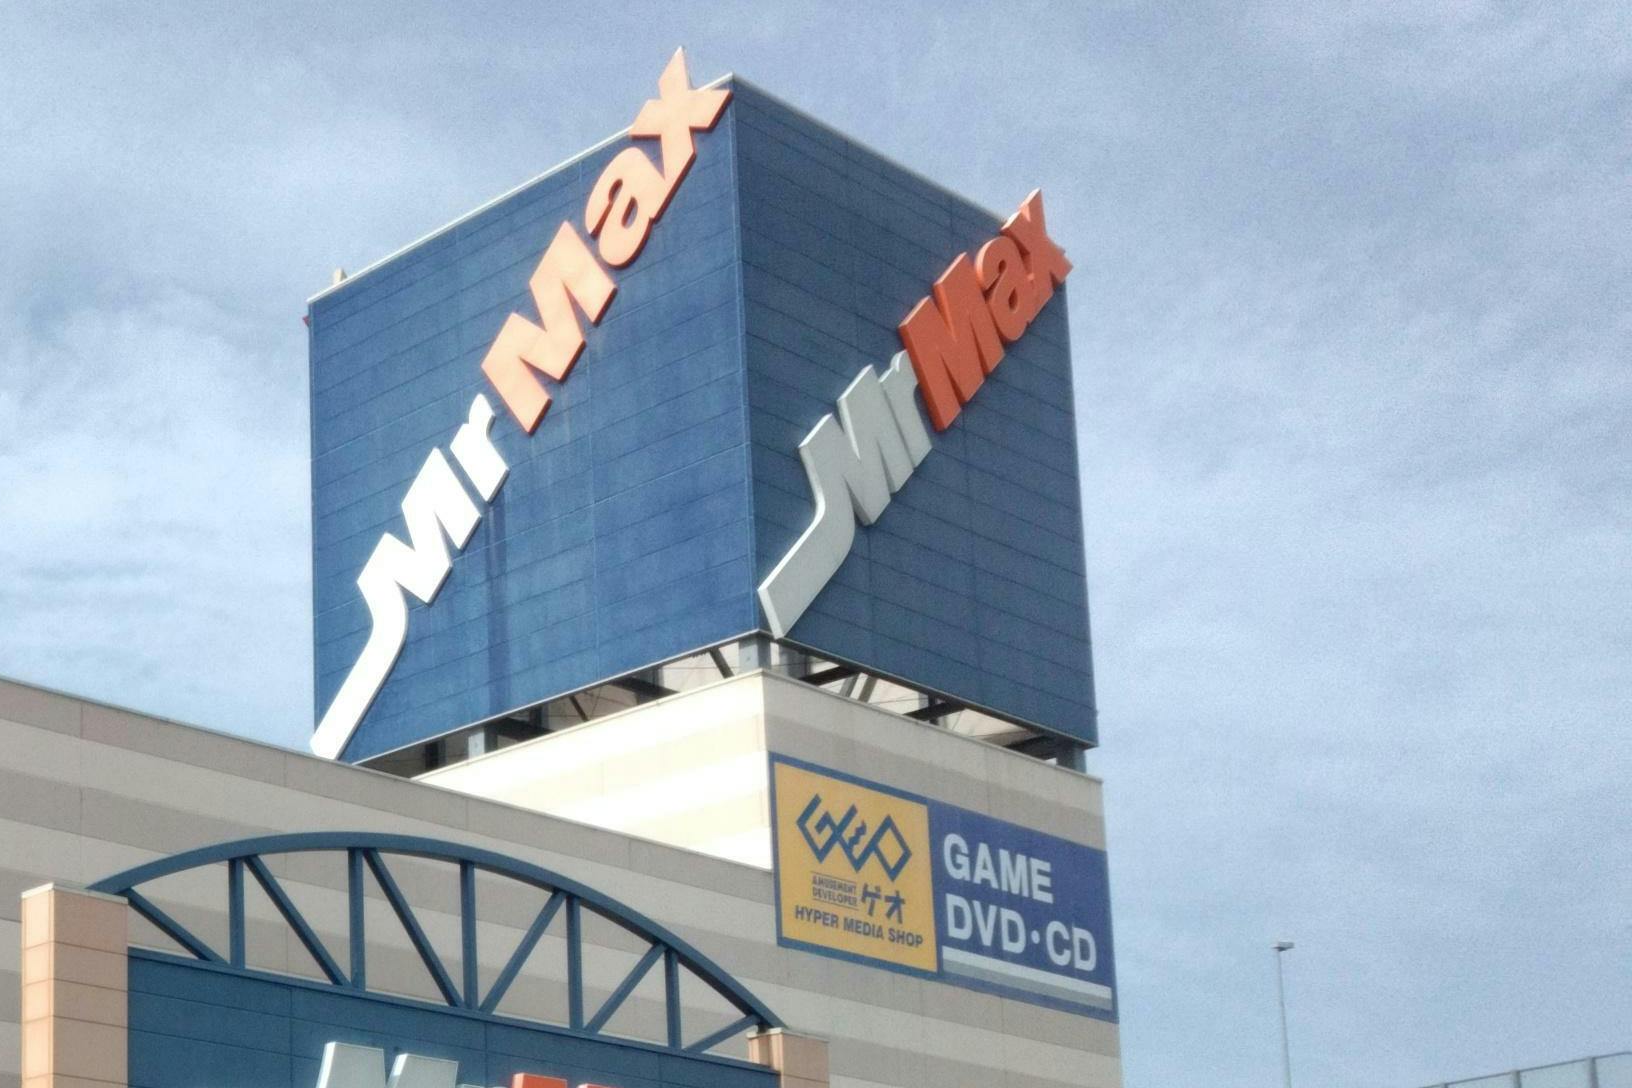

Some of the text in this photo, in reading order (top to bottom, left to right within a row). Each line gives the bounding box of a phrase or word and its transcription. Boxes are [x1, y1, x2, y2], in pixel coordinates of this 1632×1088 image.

[310, 47, 734, 761] MrMax
[758, 188, 1073, 638] MrMax
[812, 875, 857, 895] AMUSEMENT
[943, 833, 1054, 904] GAME
[812, 887, 858, 907] DEVELOPER
[861, 883, 905, 924] ゲオ
[795, 904, 923, 948] HYPER MEDIA SHOP
